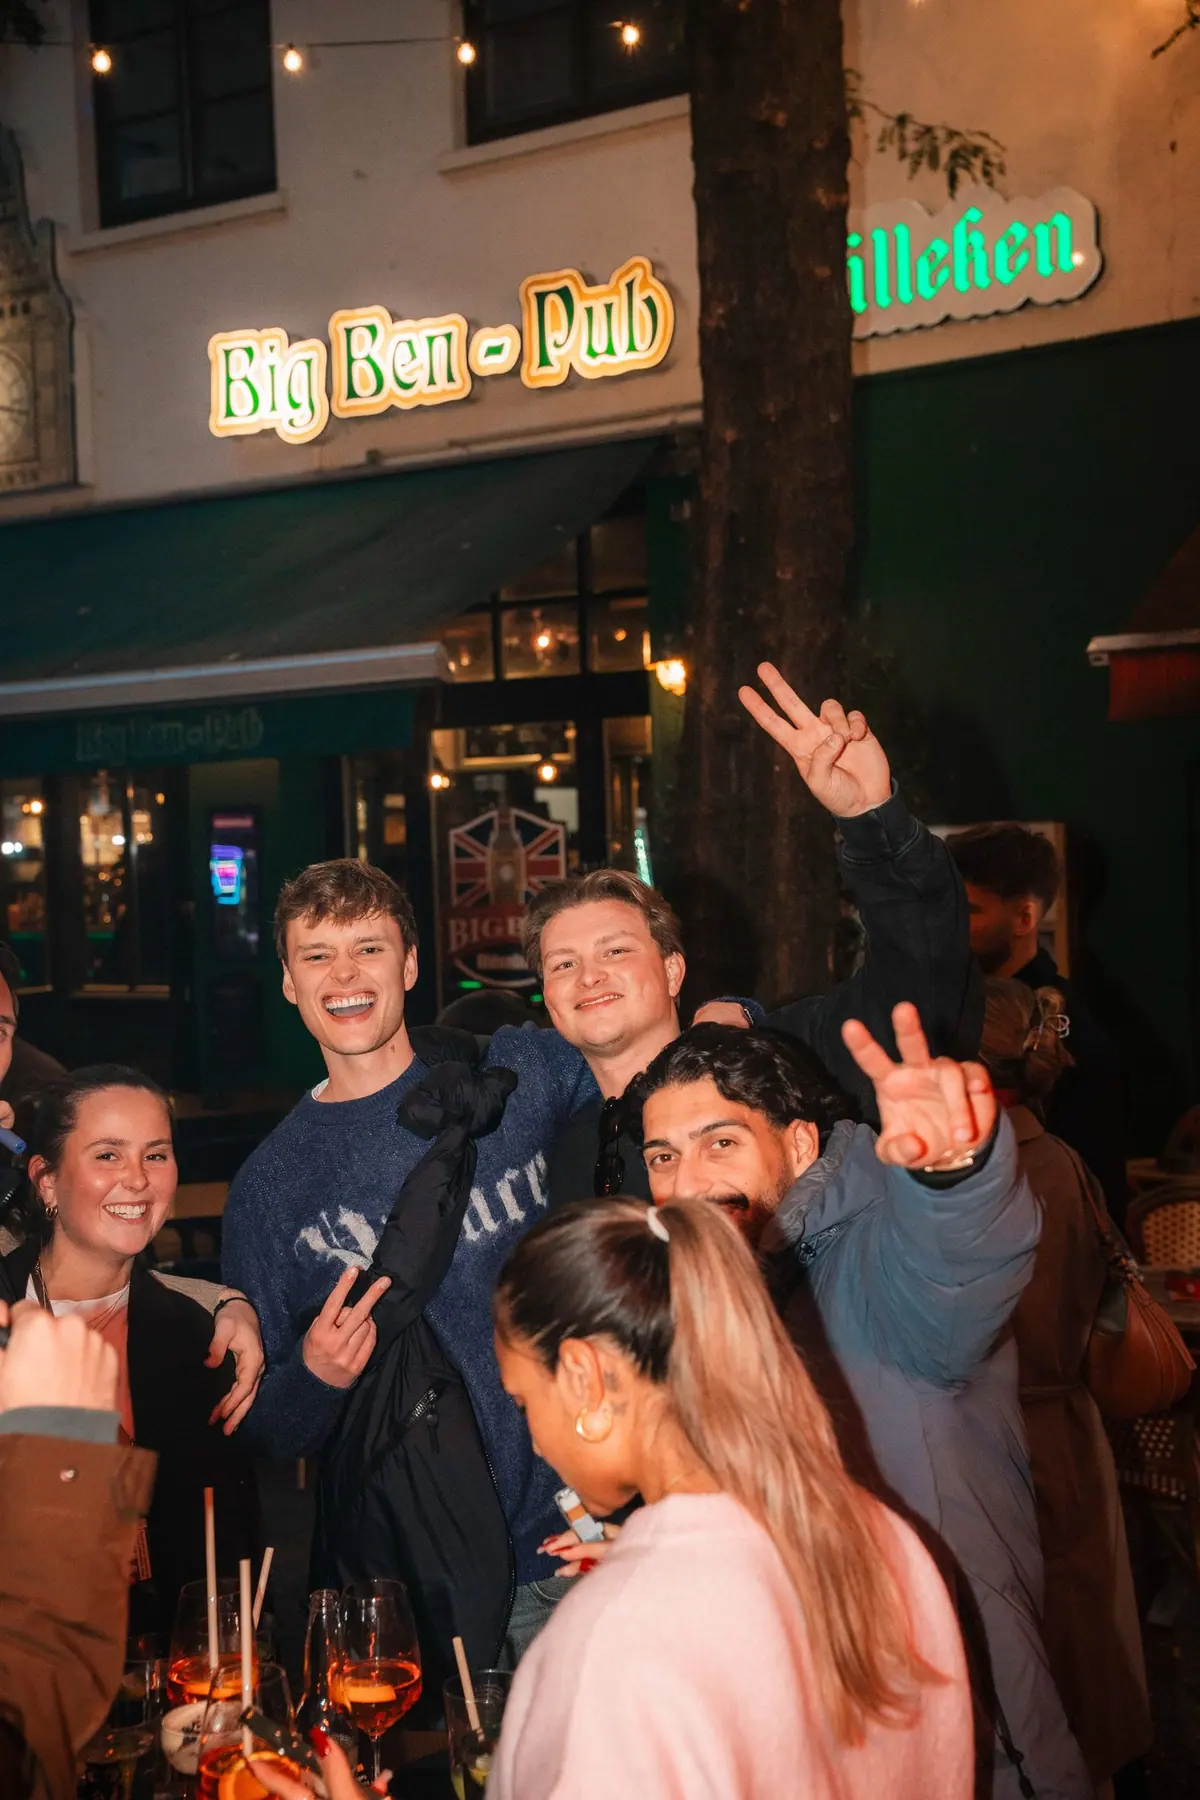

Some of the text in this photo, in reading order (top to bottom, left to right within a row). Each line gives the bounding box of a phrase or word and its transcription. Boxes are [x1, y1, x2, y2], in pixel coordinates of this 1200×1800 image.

[221, 343, 317, 429] Big
[342, 321, 459, 401] Ben
[532, 277, 659, 369] Pub
